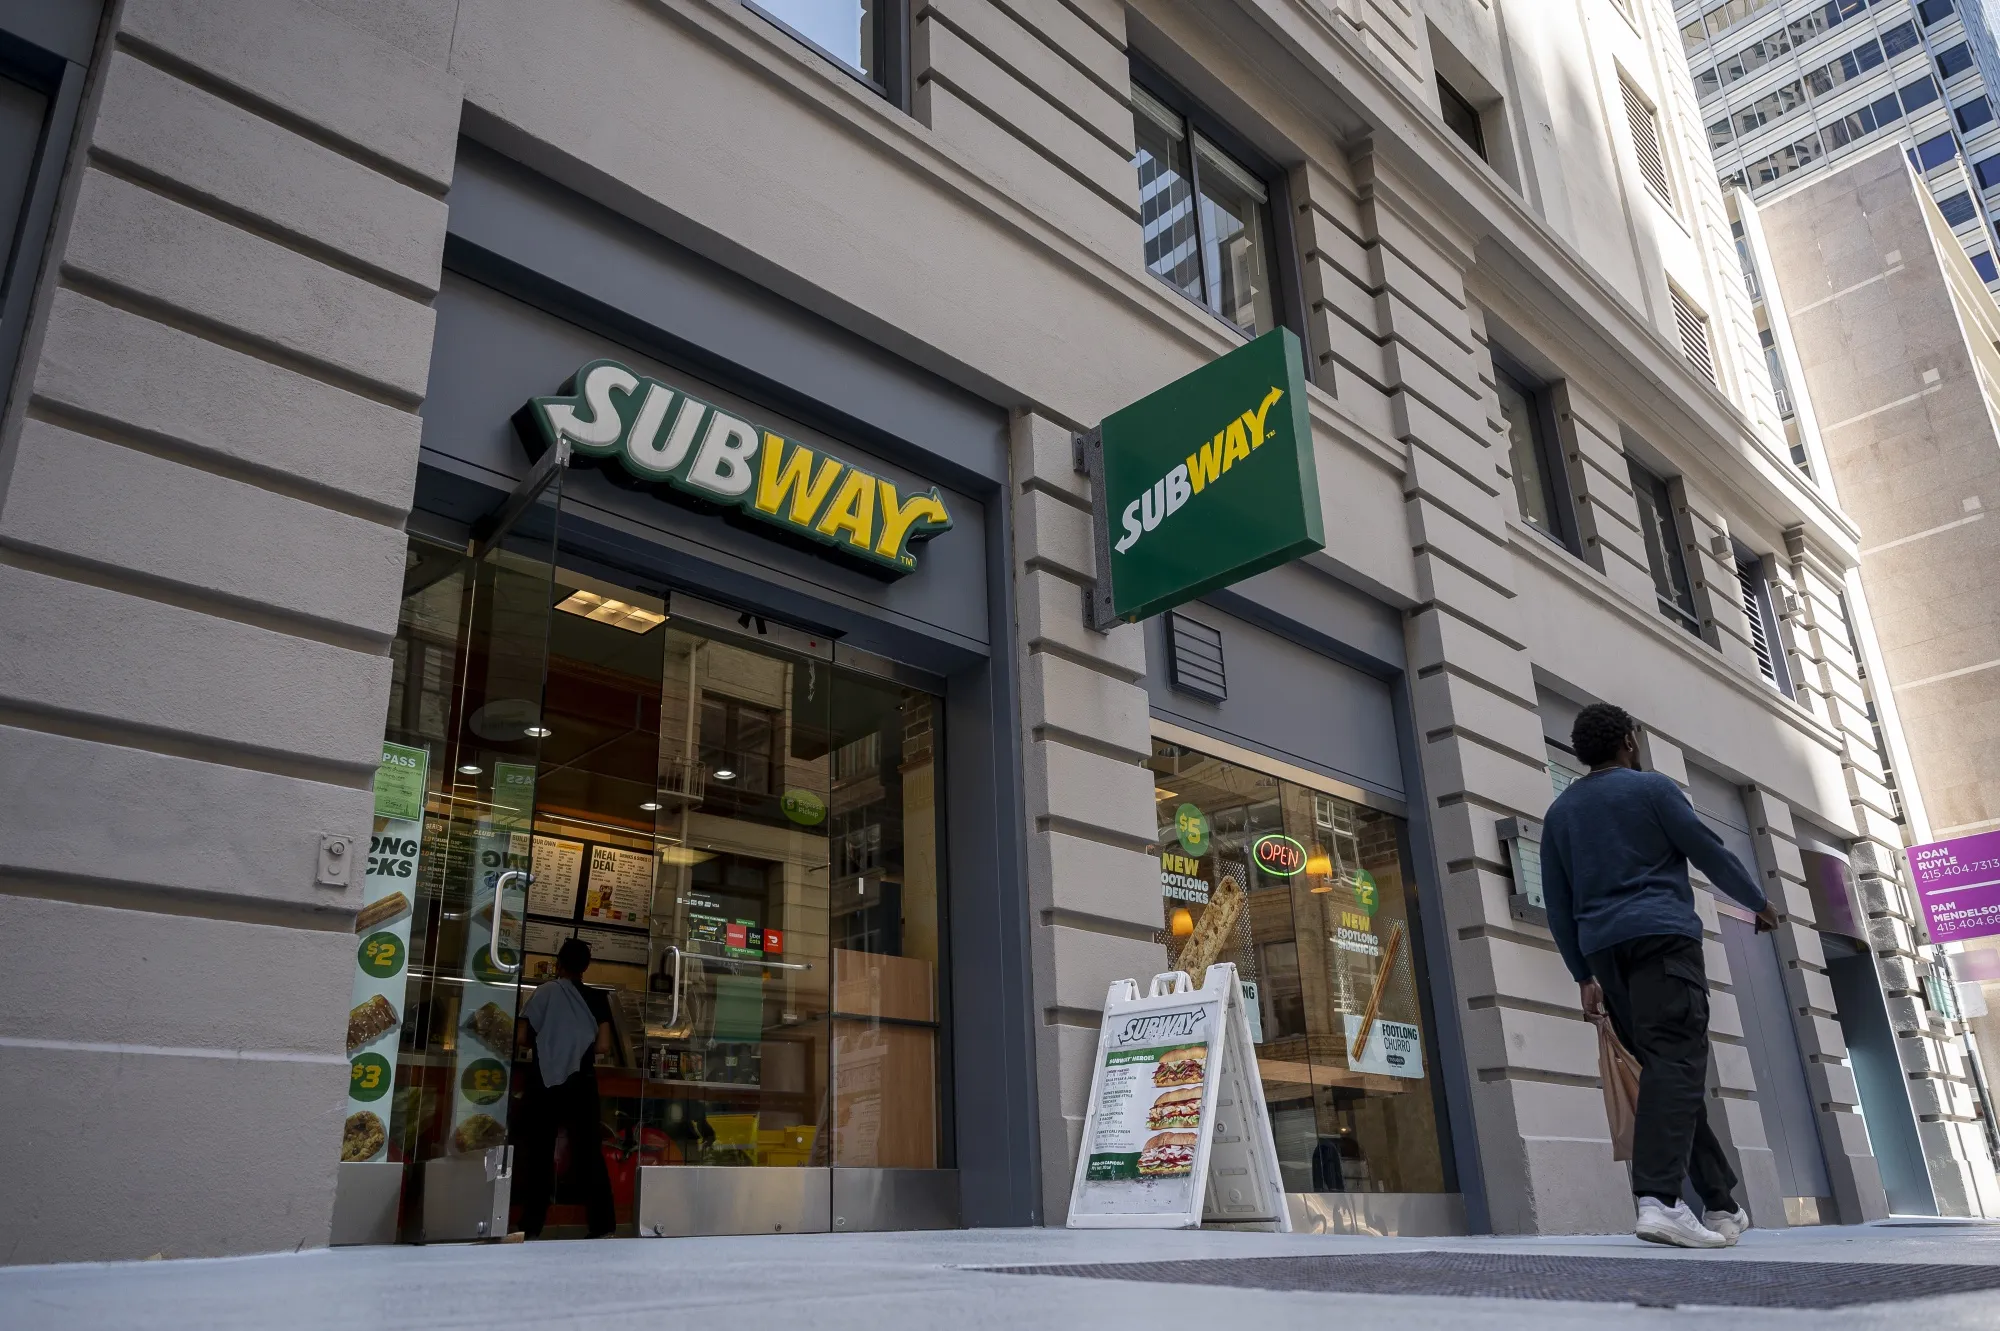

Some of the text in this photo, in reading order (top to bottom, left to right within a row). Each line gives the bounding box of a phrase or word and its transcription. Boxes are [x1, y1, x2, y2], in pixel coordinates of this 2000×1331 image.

[543, 366, 948, 559] SUBWAY
[1114, 386, 1285, 555] SUBWAY
[382, 752, 416, 768] PASS
[1178, 813, 1201, 845] $5
[593, 849, 617, 861] MEAL
[1162, 852, 1199, 876] NEW
[1260, 840, 1299, 868] OPEN
[1916, 847, 1949, 861] JOAN
[1917, 856, 1958, 871] RUYLE
[592, 859, 616, 872] DEAL
[1921, 858, 2000, 880] 415.404.7313
[1160, 872, 1209, 892] OOTLONG
[1930, 901, 1956, 913] PAM
[1341, 911, 1370, 932] NEW
[1337, 927, 1379, 945] FOOTLONG
[366, 940, 397, 967] $2
[1337, 939, 1379, 957] SIDEKICKS
[1117, 1006, 1206, 1045] SUBWAY
[1381, 1023, 1418, 1041] FOOTLONG
[1383, 1037, 1411, 1053] CHURRO
[351, 1062, 382, 1089] $3
